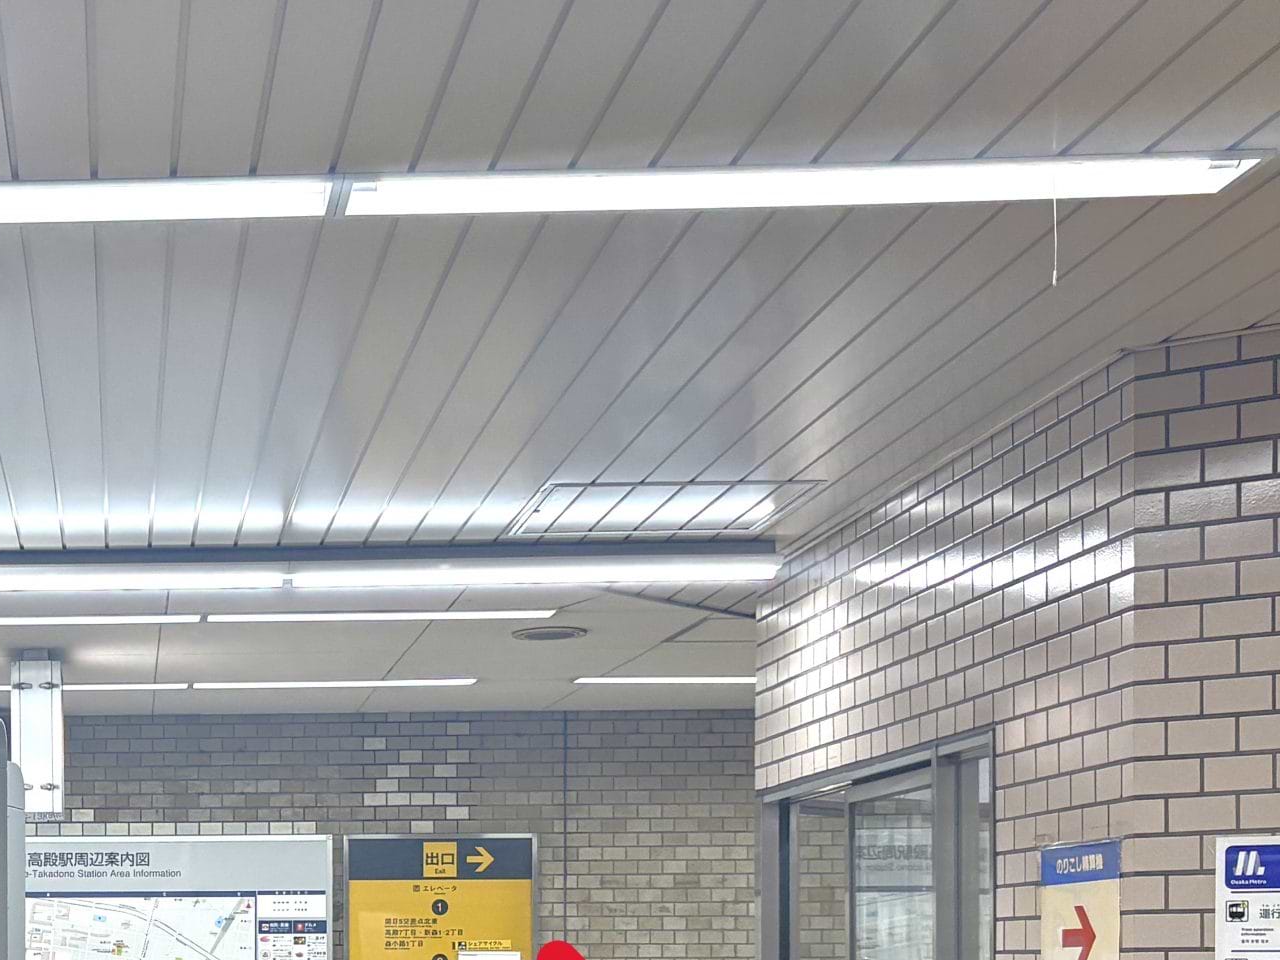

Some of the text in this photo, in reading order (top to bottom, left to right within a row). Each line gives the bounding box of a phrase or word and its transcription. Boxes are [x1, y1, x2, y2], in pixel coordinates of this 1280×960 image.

[27, 852, 151, 867] 高殿駅周辺案内図
[426, 853, 455, 866] 出口
[78, 869, 108, 878] Station
[110, 869, 131, 878] Area
[133, 869, 182, 878] Information
